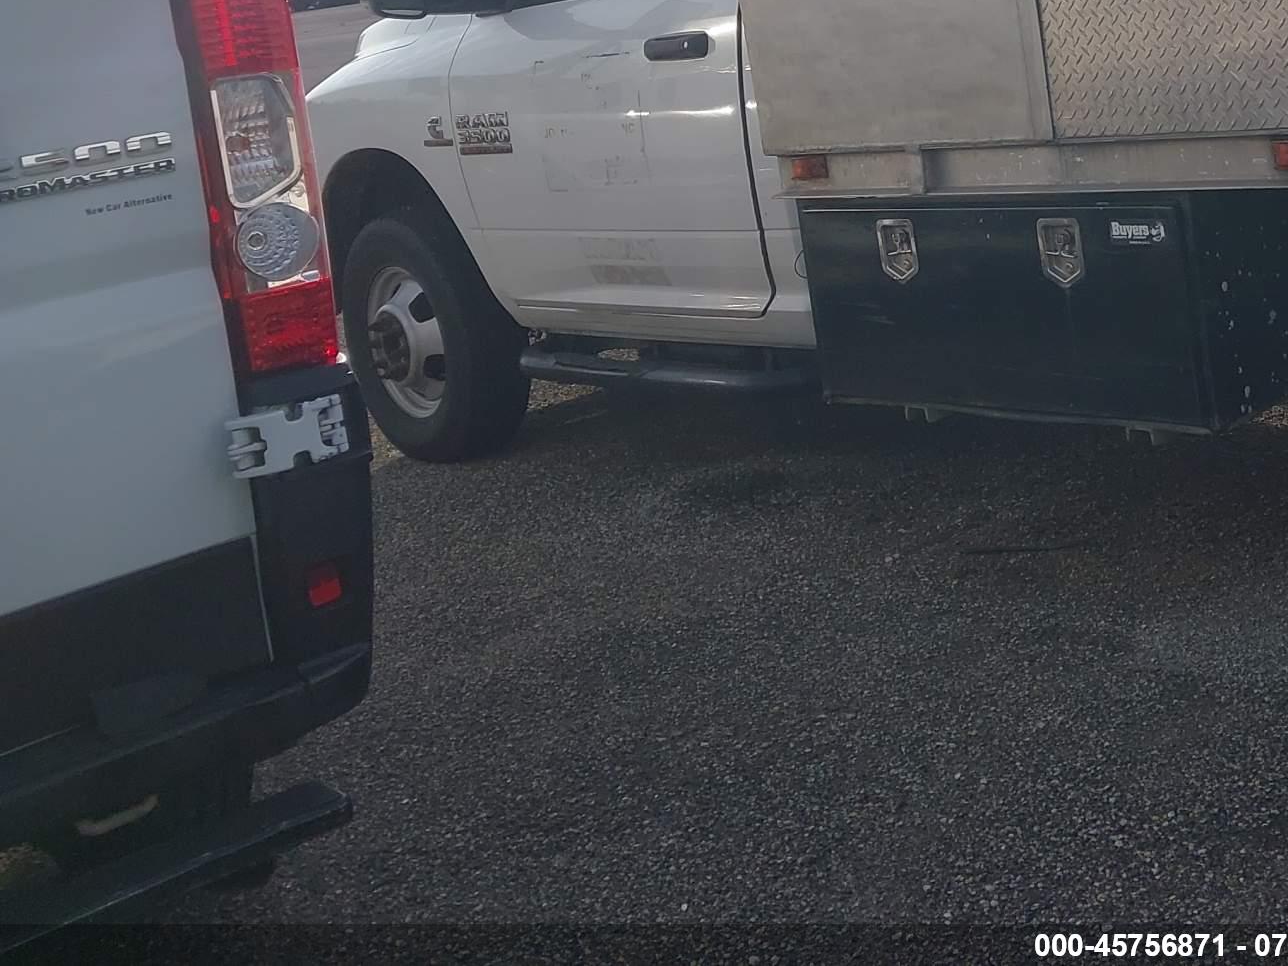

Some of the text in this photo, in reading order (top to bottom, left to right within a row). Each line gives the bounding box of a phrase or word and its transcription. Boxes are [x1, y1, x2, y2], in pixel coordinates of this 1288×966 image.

[455, 112, 509, 129] RAM
[458, 127, 511, 145] 3500
[85, 193, 173, 216] New Car Alternative
[1110, 221, 1150, 239] Buyers
